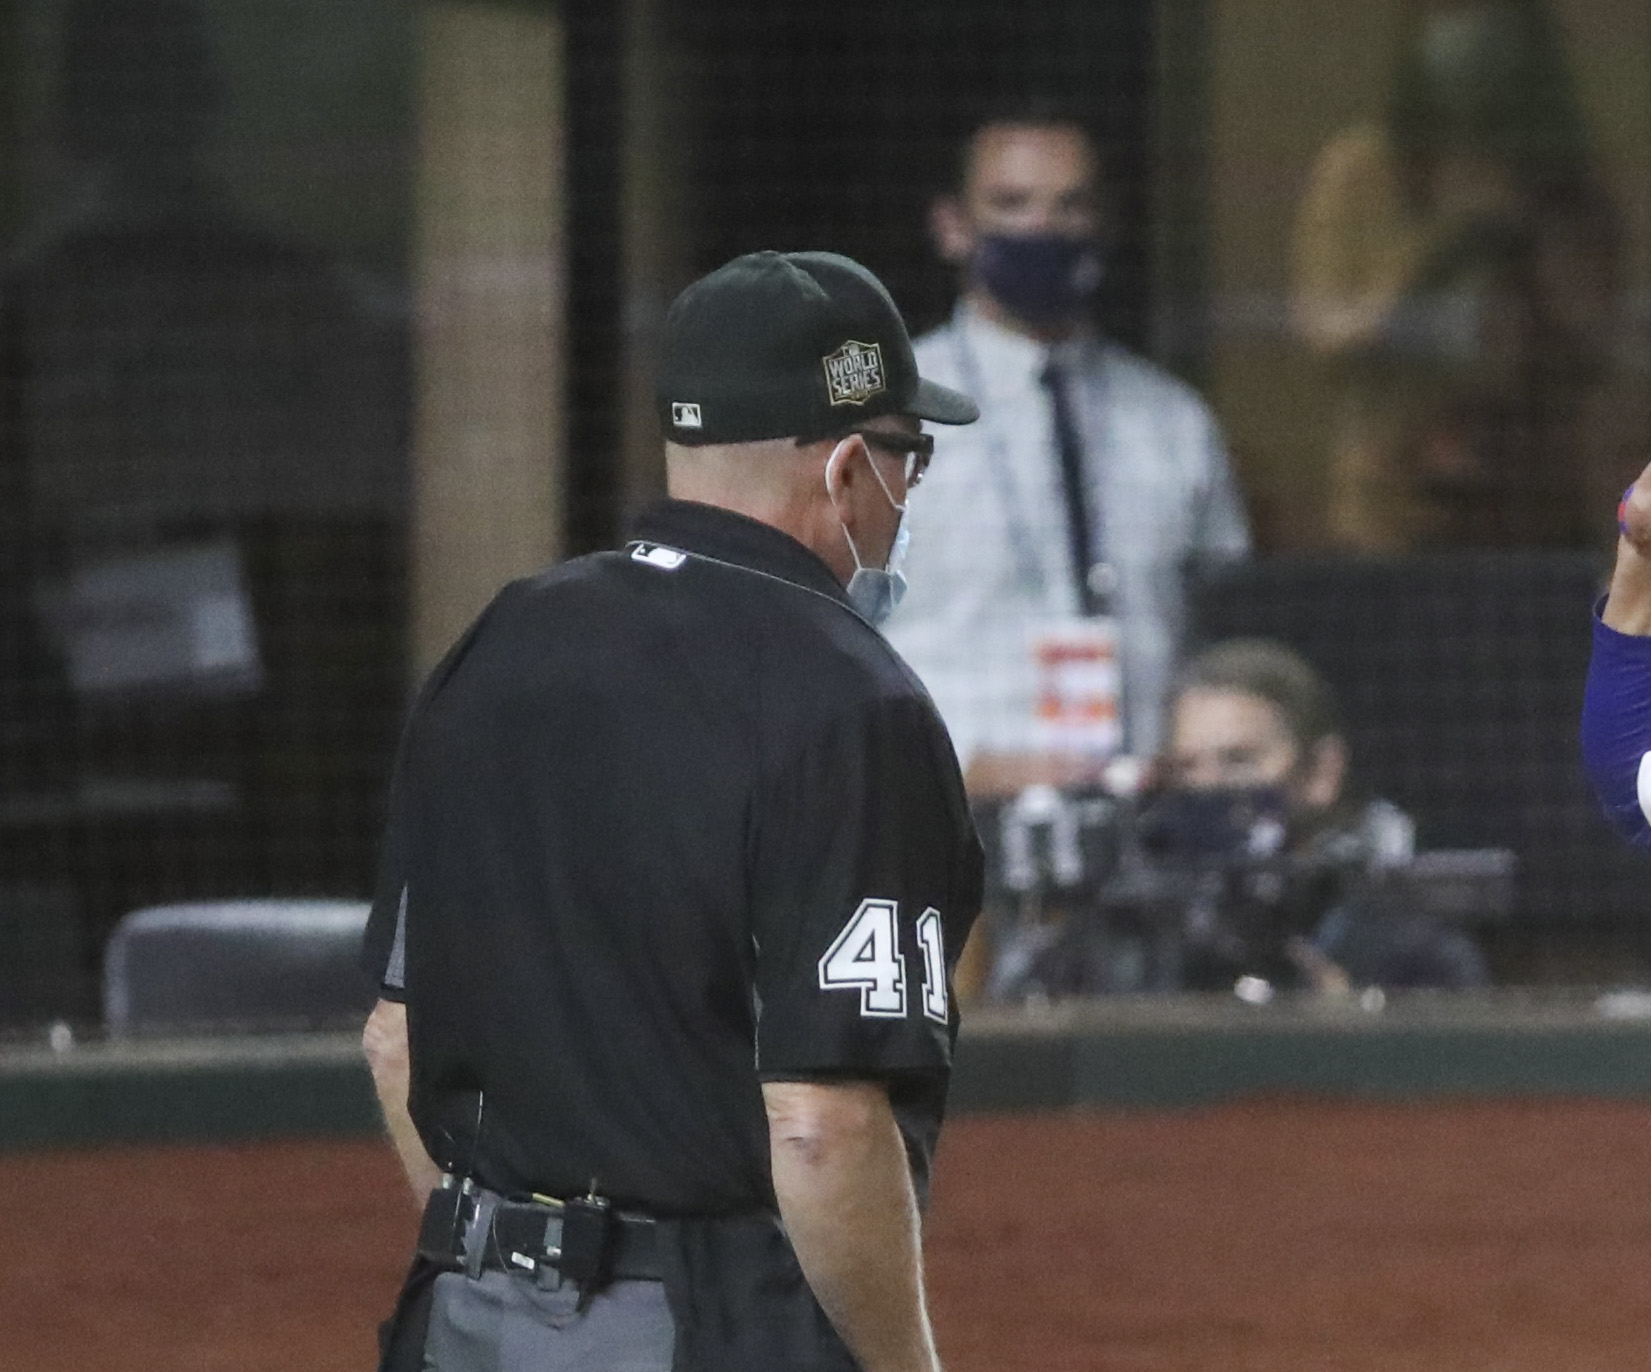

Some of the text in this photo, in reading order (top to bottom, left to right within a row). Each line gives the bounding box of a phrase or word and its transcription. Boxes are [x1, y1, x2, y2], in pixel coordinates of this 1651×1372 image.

[829, 351, 878, 378] WORLD
[832, 368, 881, 397] SERIES
[818, 898, 948, 1025] 41
